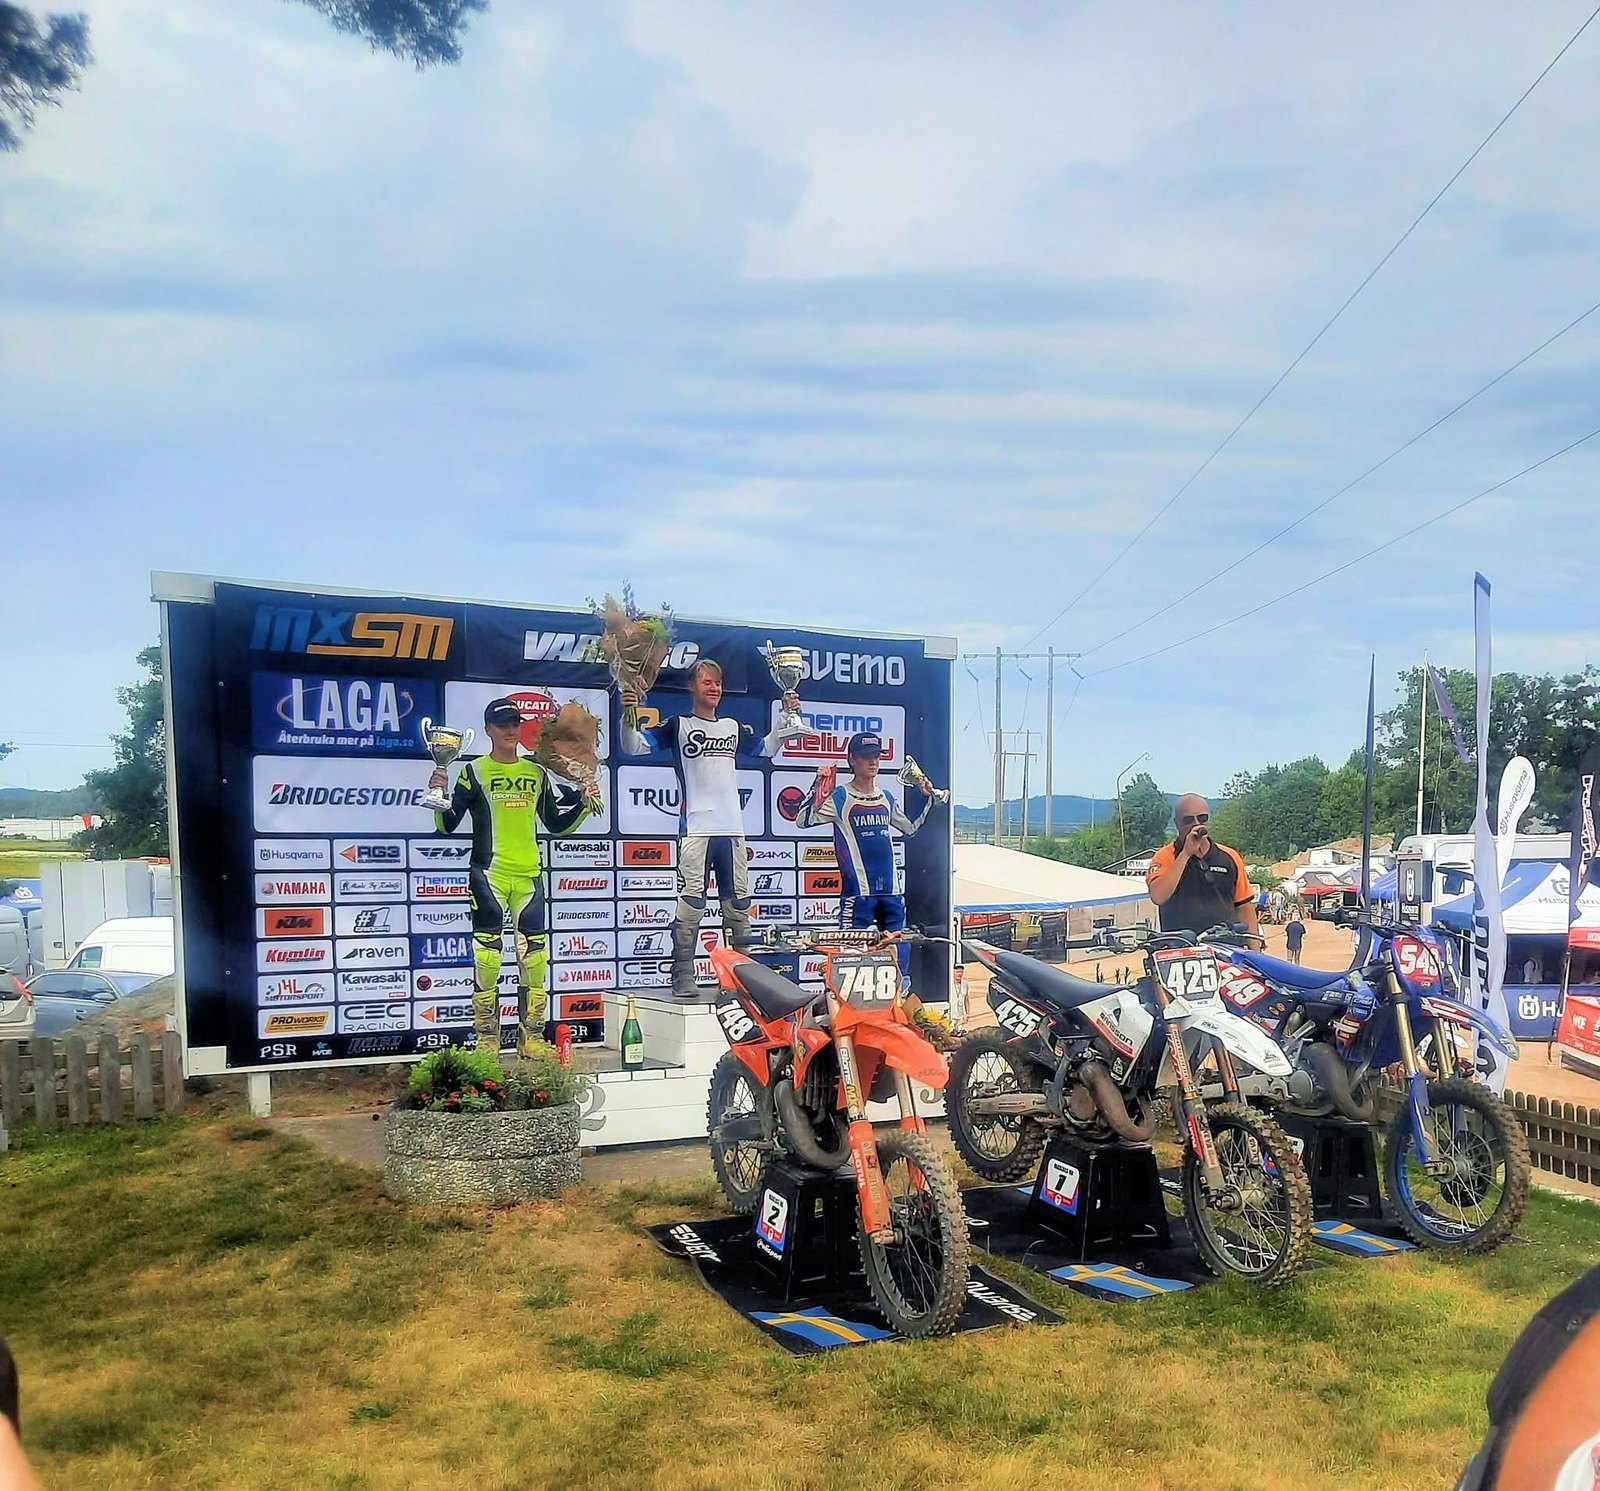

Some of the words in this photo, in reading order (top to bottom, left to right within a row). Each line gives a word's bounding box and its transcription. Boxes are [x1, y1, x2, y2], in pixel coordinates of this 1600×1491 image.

[292, 678, 400, 732] LAGA
[799, 711, 883, 733] hermo
[277, 730, 335, 745] Återbruka
[336, 735, 359, 746] mer
[360, 734, 374, 748] på
[376, 736, 414, 749] laga.se
[490, 777, 536, 793] FXR
[269, 783, 425, 806] BRIDGESTONE
[629, 788, 679, 807] TRIU
[1504, 768, 1528, 823] Husqvarna
[357, 845, 401, 858] RG3
[417, 847, 473, 857] FLY
[554, 841, 610, 852] Kawasaki
[271, 850, 324, 860] Husqvarna
[632, 848, 662, 860] KTM
[756, 851, 793, 859] 24MX
[414, 876, 467, 885] Thermo
[755, 872, 783, 890] #1
[812, 877, 839, 888] KTM
[276, 882, 326, 895] YAMAHA
[356, 907, 390, 927] #1
[416, 913, 463, 922] TRIUMPH
[556, 912, 610, 920] BRIDGESTONE
[758, 905, 792, 916] RG3
[275, 915, 313, 929] KTM
[635, 932, 664, 951] #1
[818, 931, 876, 940] RENTHAL
[359, 946, 404, 959] raven
[426, 937, 468, 958] LAGA
[342, 971, 407, 985] Kawasaki
[570, 970, 612, 982] YAMAHA
[1167, 959, 1218, 996] 425
[838, 965, 897, 1003] 748
[264, 993, 325, 1002] MOTORSPORT
[569, 1000, 601, 1012] KTM
[716, 999, 755, 1041] 748
[995, 999, 1042, 1039] 425
[343, 1021, 406, 1032] RACING
[569, 1025, 588, 1036] SR
[416, 1033, 451, 1048] PSR
[259, 1043, 298, 1058] PSR
[852, 1149, 866, 1189] MOTUL
[1054, 1173, 1067, 1192] 1
[767, 1205, 780, 1226] 2
